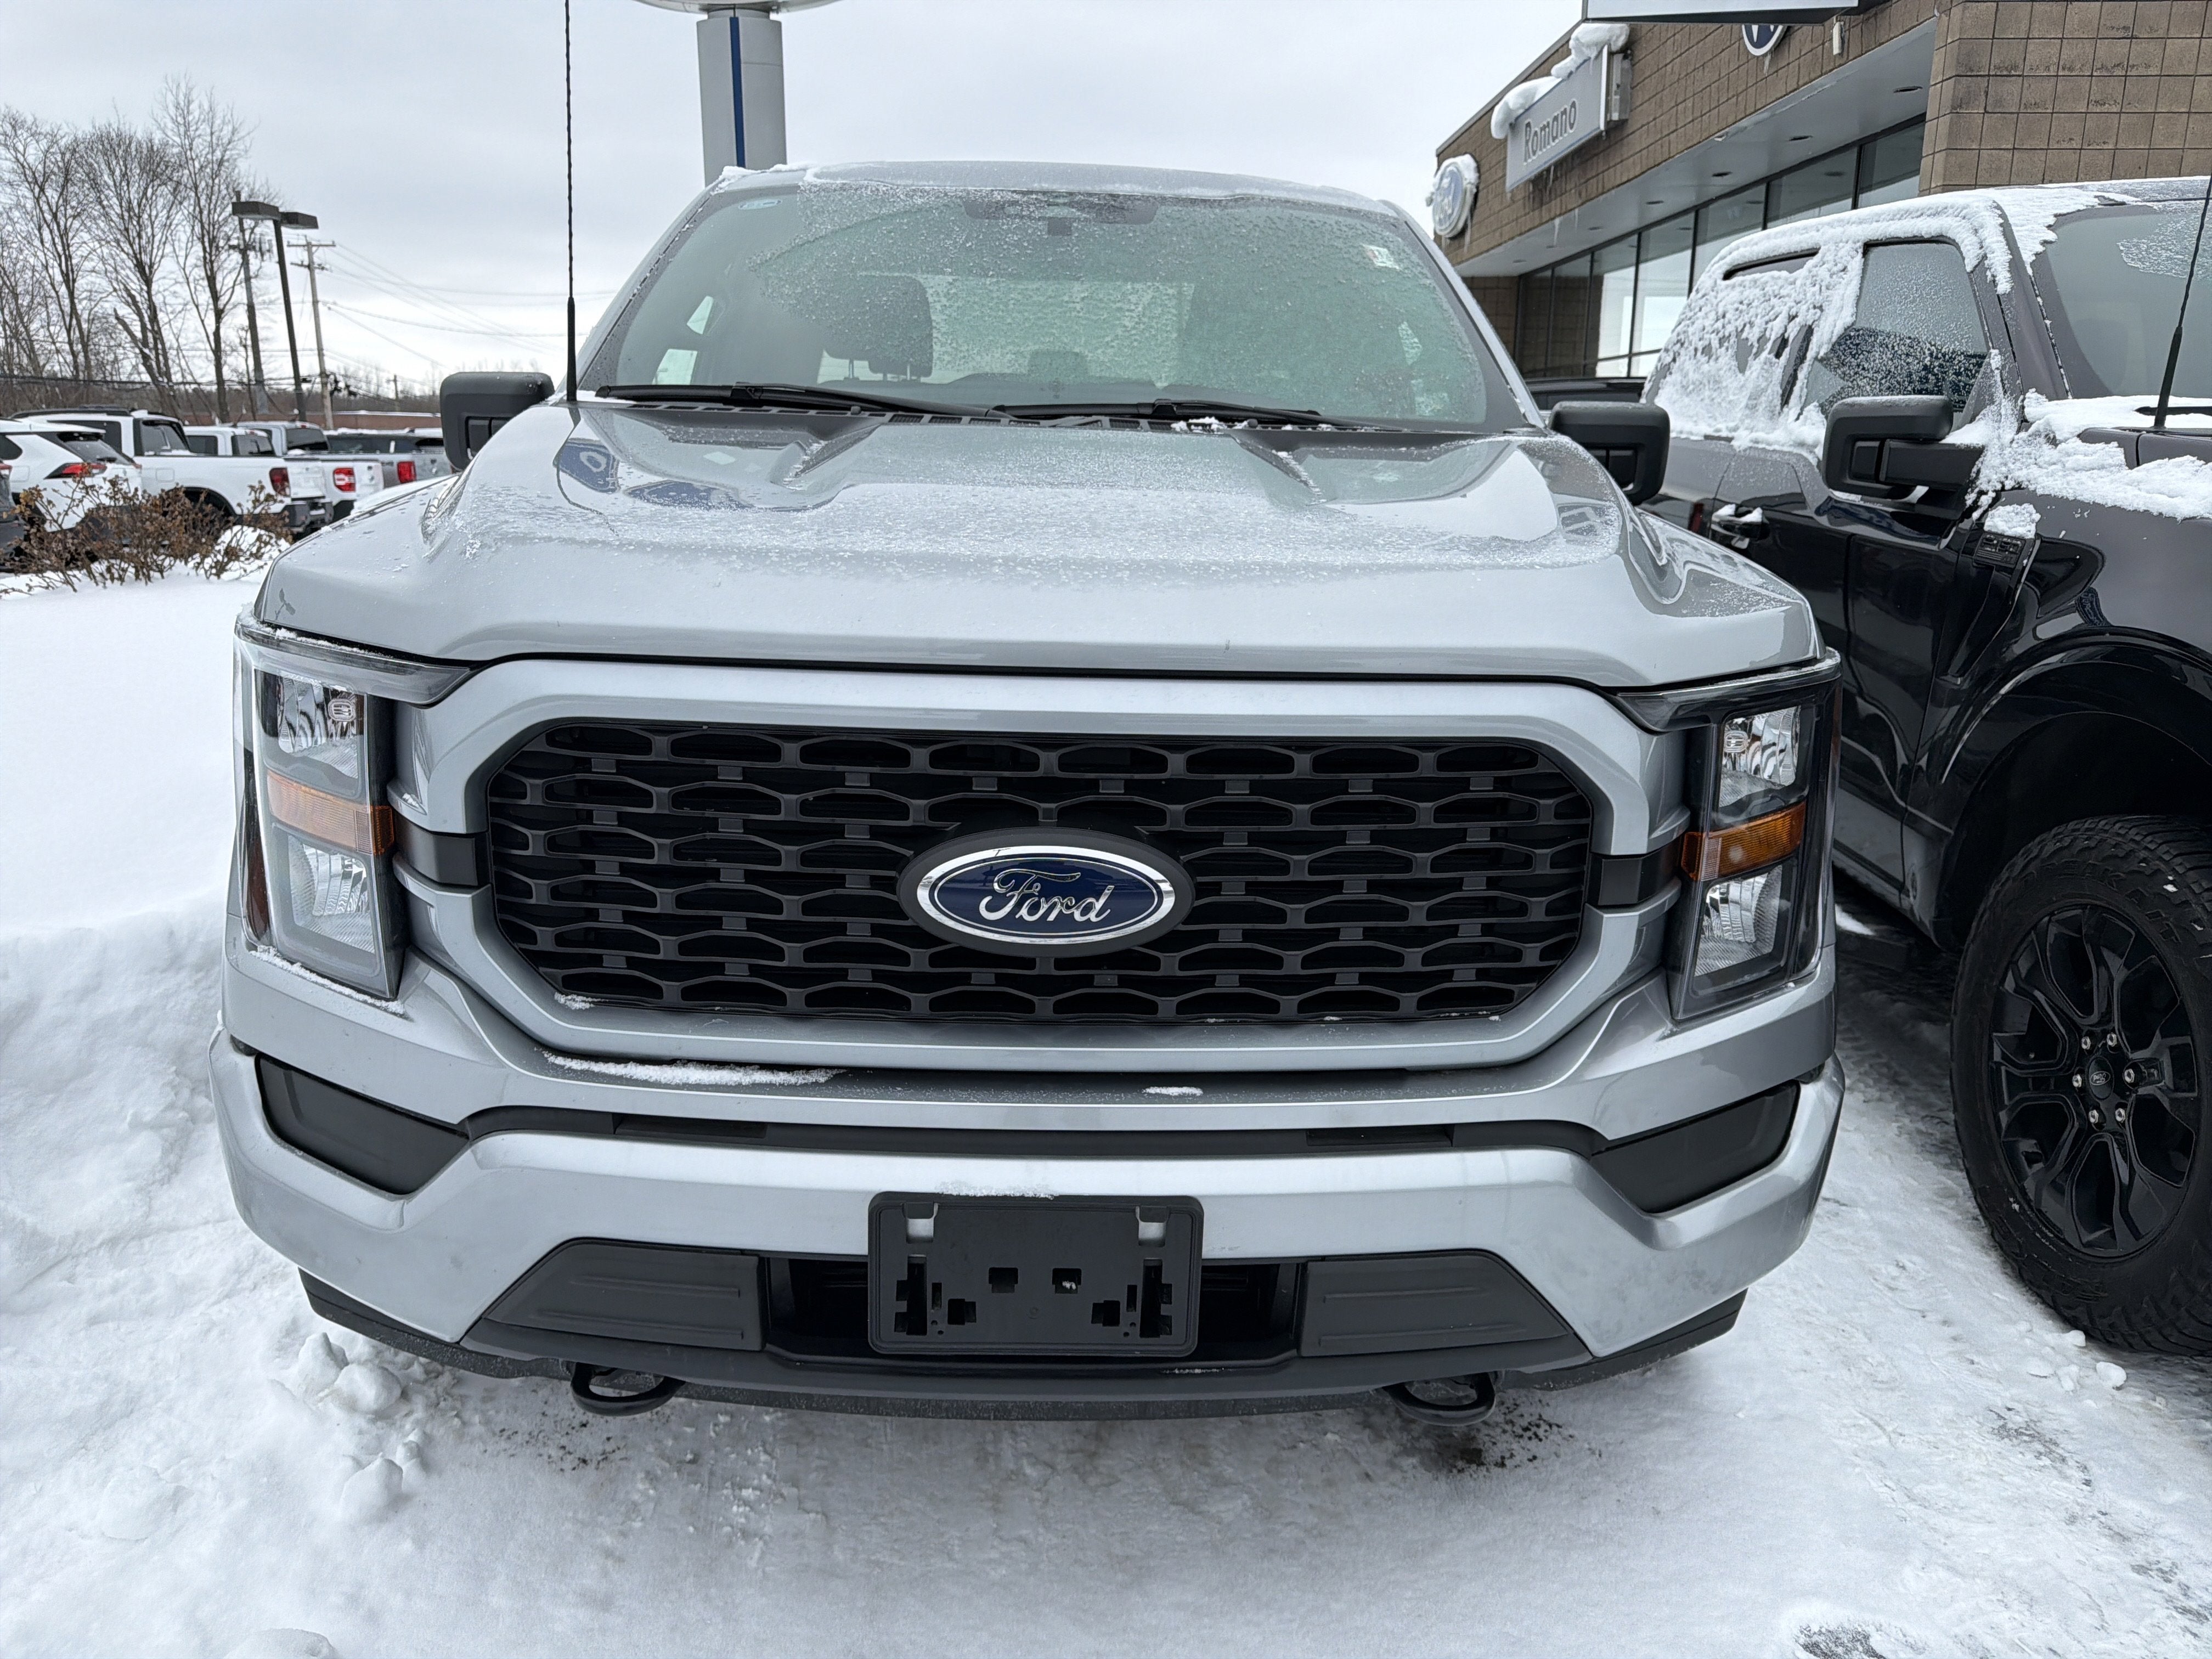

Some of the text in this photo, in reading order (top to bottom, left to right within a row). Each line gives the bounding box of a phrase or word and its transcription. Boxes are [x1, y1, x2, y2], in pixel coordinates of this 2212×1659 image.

[1524, 99, 1577, 163] Romano
[979, 868, 1114, 922] Ford
[2093, 1073, 2106, 1084] Ford
